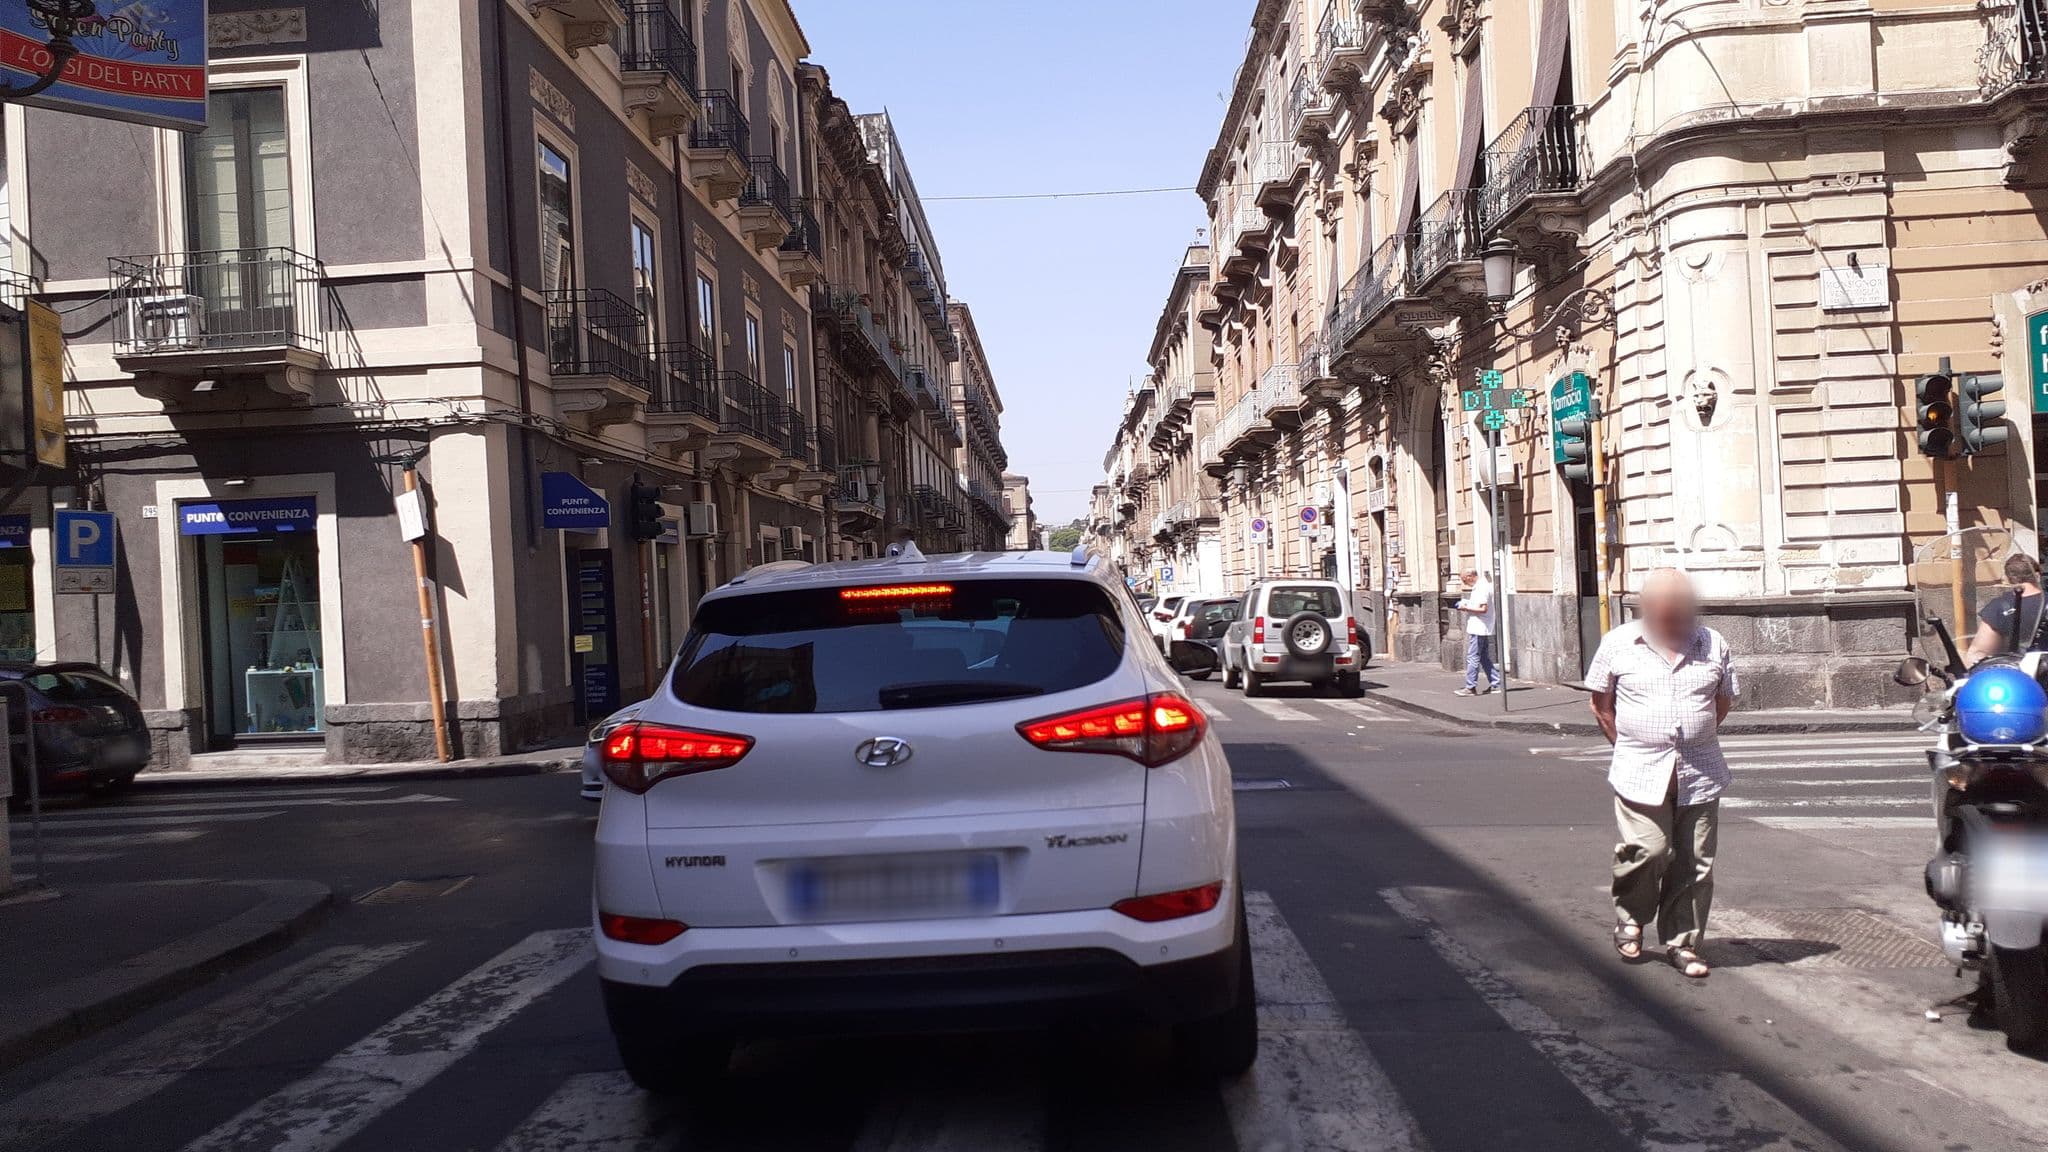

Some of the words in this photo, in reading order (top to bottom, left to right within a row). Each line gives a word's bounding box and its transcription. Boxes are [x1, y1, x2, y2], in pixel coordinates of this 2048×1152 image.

[107, 15, 178, 61] Party
[18, 45, 81, 77] L'OSI
[88, 63, 127, 86] DEL
[132, 70, 192, 92] PARTY
[228, 509, 309, 522] CONVENIENZA
[547, 507, 606, 515] CONVENIENZA
[69, 519, 100, 559] P
[665, 855, 726, 867] HYUNDAI
